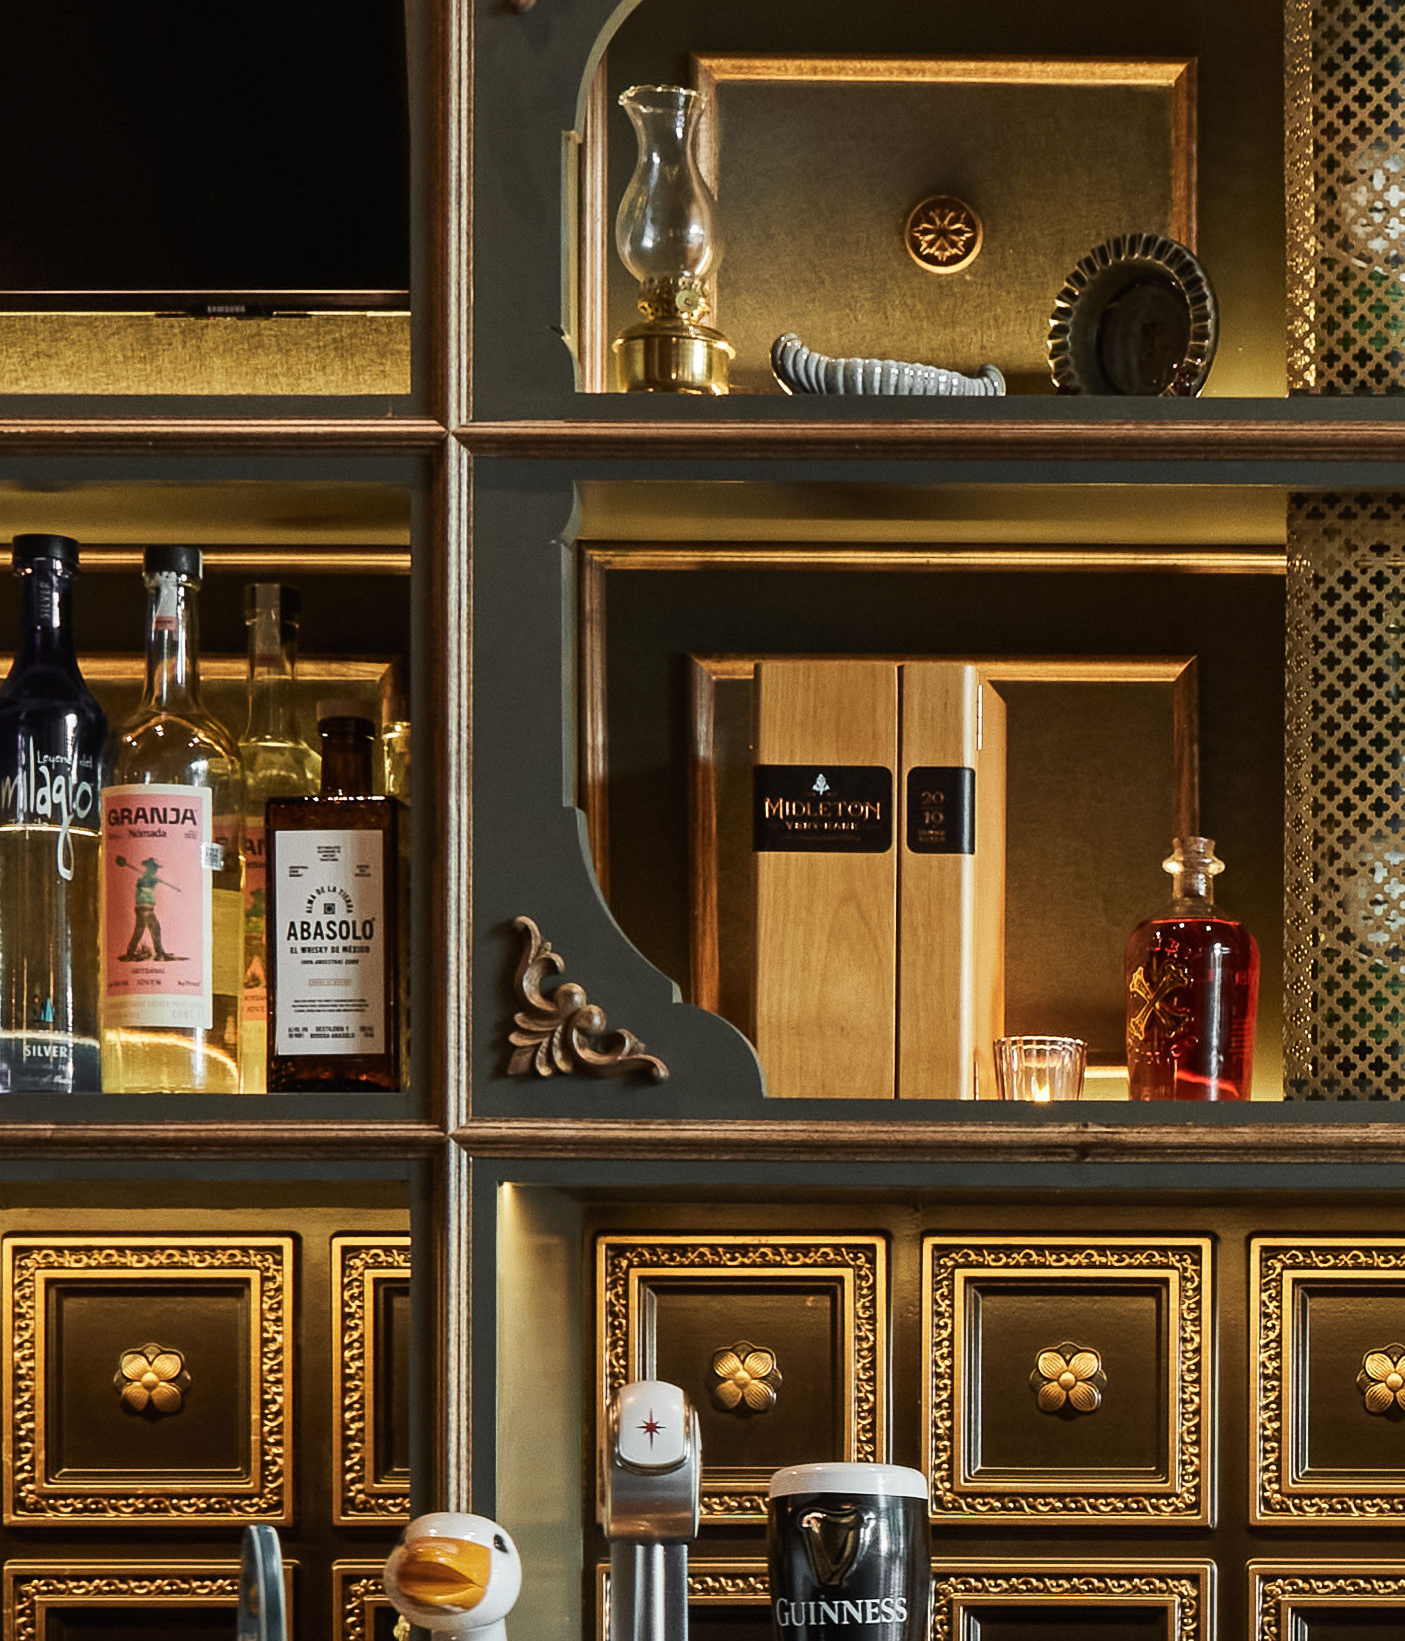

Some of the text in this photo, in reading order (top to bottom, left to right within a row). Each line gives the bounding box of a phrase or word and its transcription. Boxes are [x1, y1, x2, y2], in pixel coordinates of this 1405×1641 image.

[921, 791, 944, 804] 20
[108, 807, 198, 826] GRANJA
[764, 797, 881, 820] MIDLETON
[923, 811, 944, 824] 19
[287, 920, 374, 941] ABASOLO
[301, 946, 328, 954] WHISKY
[24, 1045, 68, 1057] SILVER
[776, 1597, 907, 1626] GUINNESS
